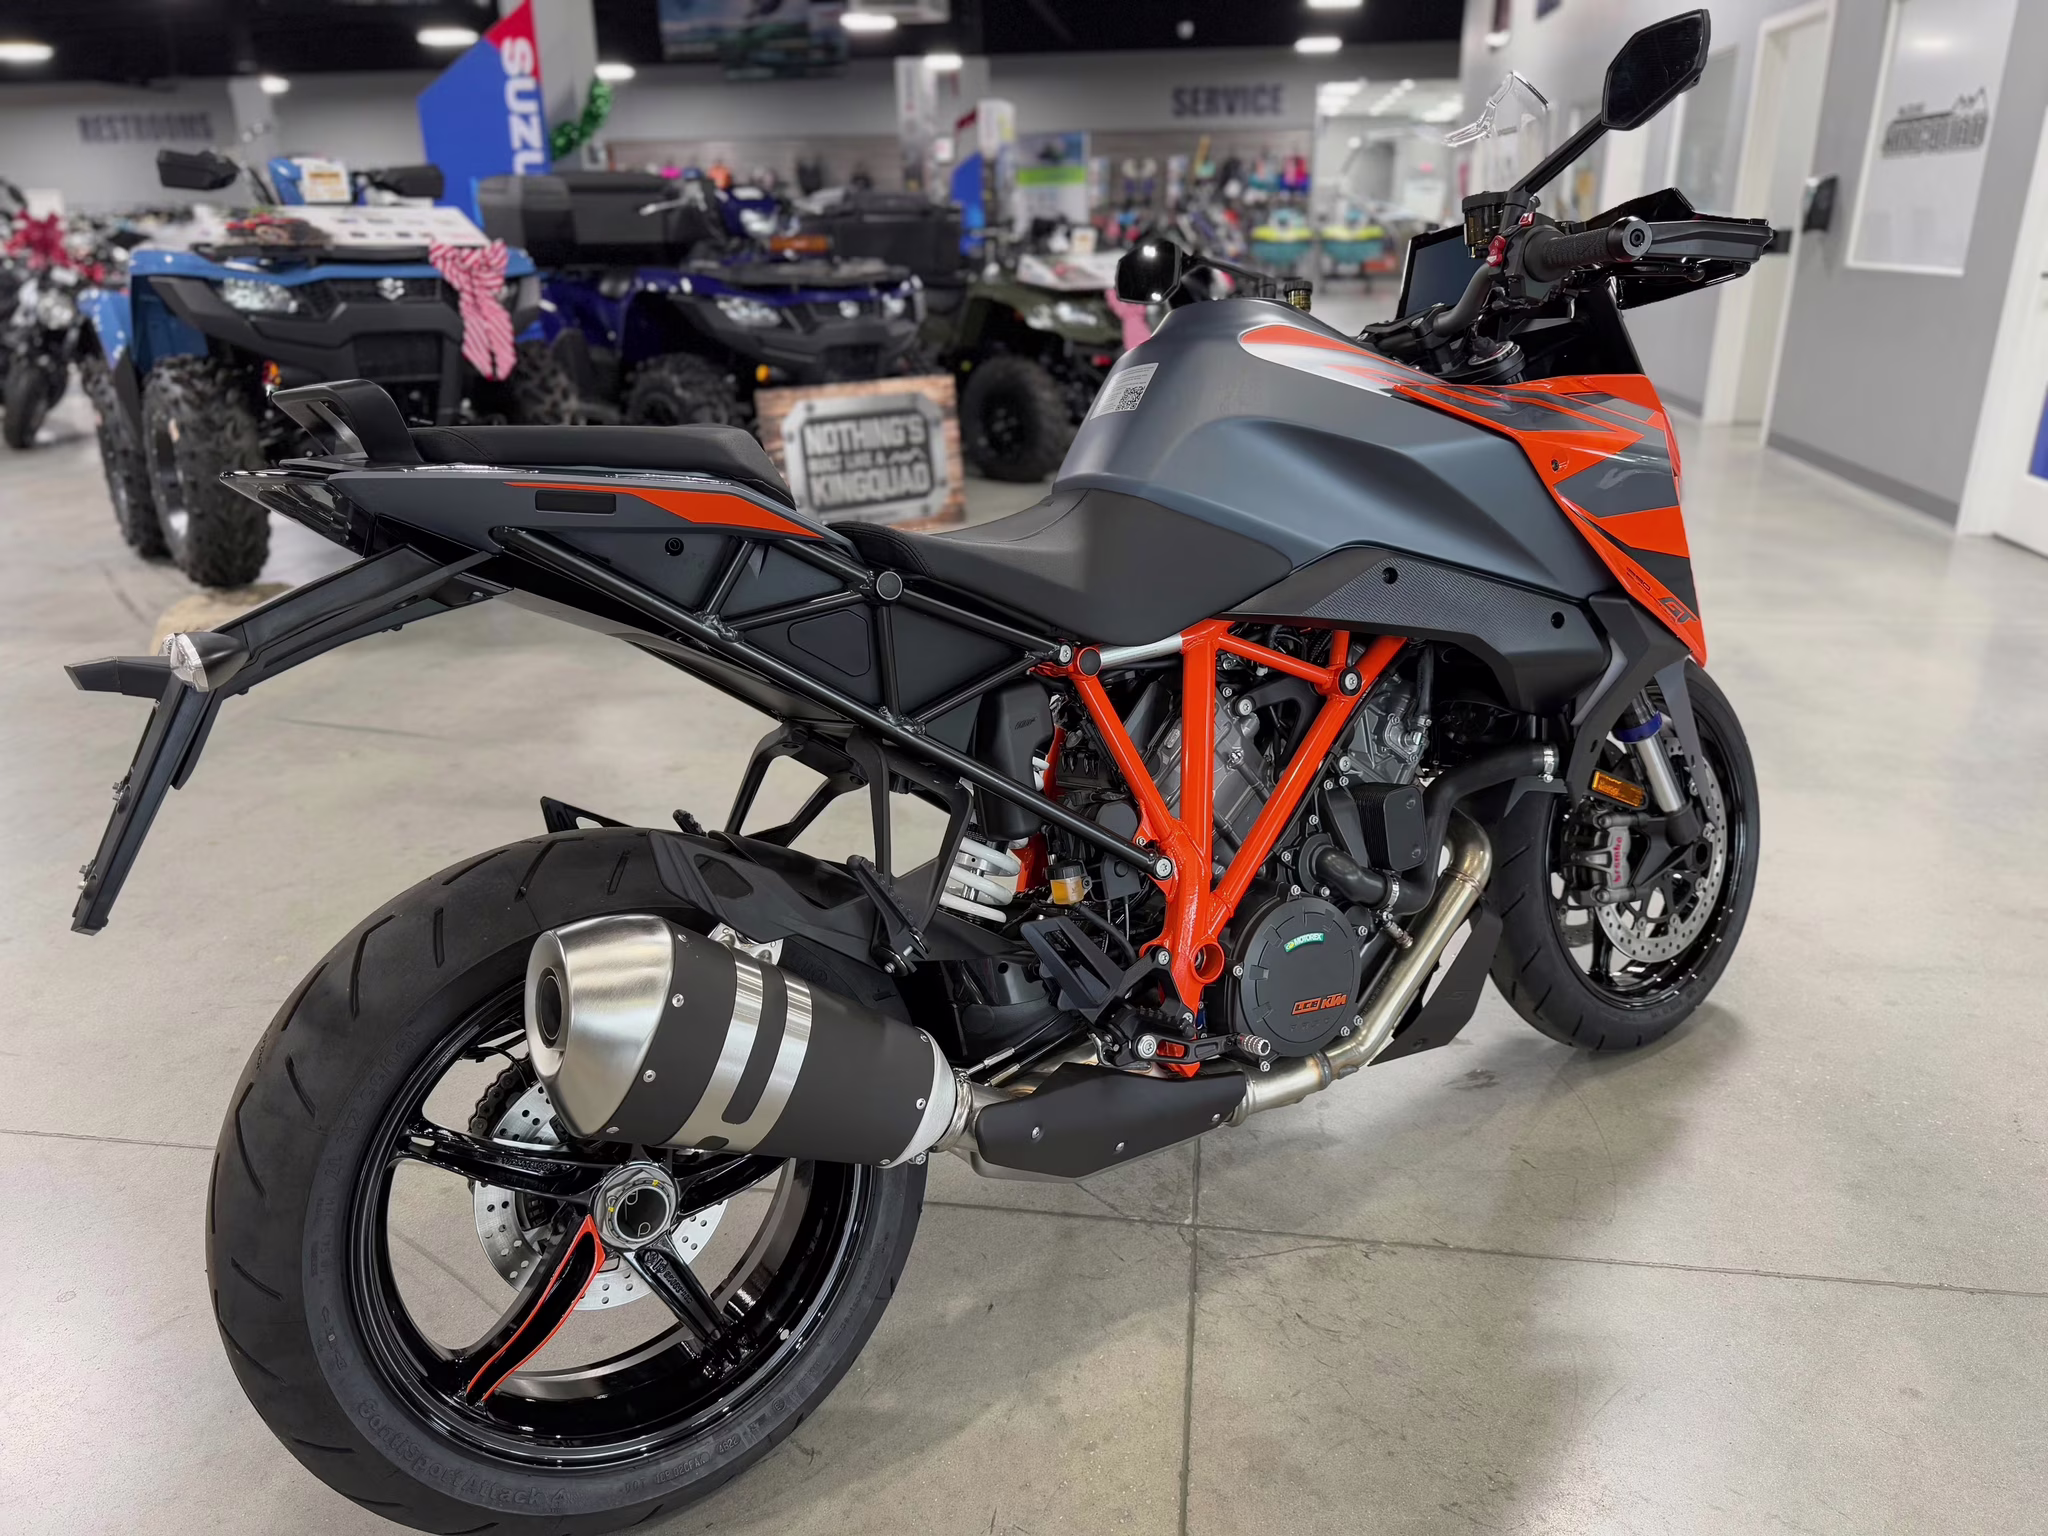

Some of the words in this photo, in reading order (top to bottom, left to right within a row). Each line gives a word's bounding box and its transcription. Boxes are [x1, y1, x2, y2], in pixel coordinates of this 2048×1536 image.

[1172, 84, 1284, 118] SERVICE
[803, 413, 925, 457] NOTHING'S
[810, 462, 931, 507] KINGQUAD
[1612, 835, 1624, 884] brembo
[1293, 932, 1324, 947] MOTOREX
[1321, 993, 1347, 1009] KTM
